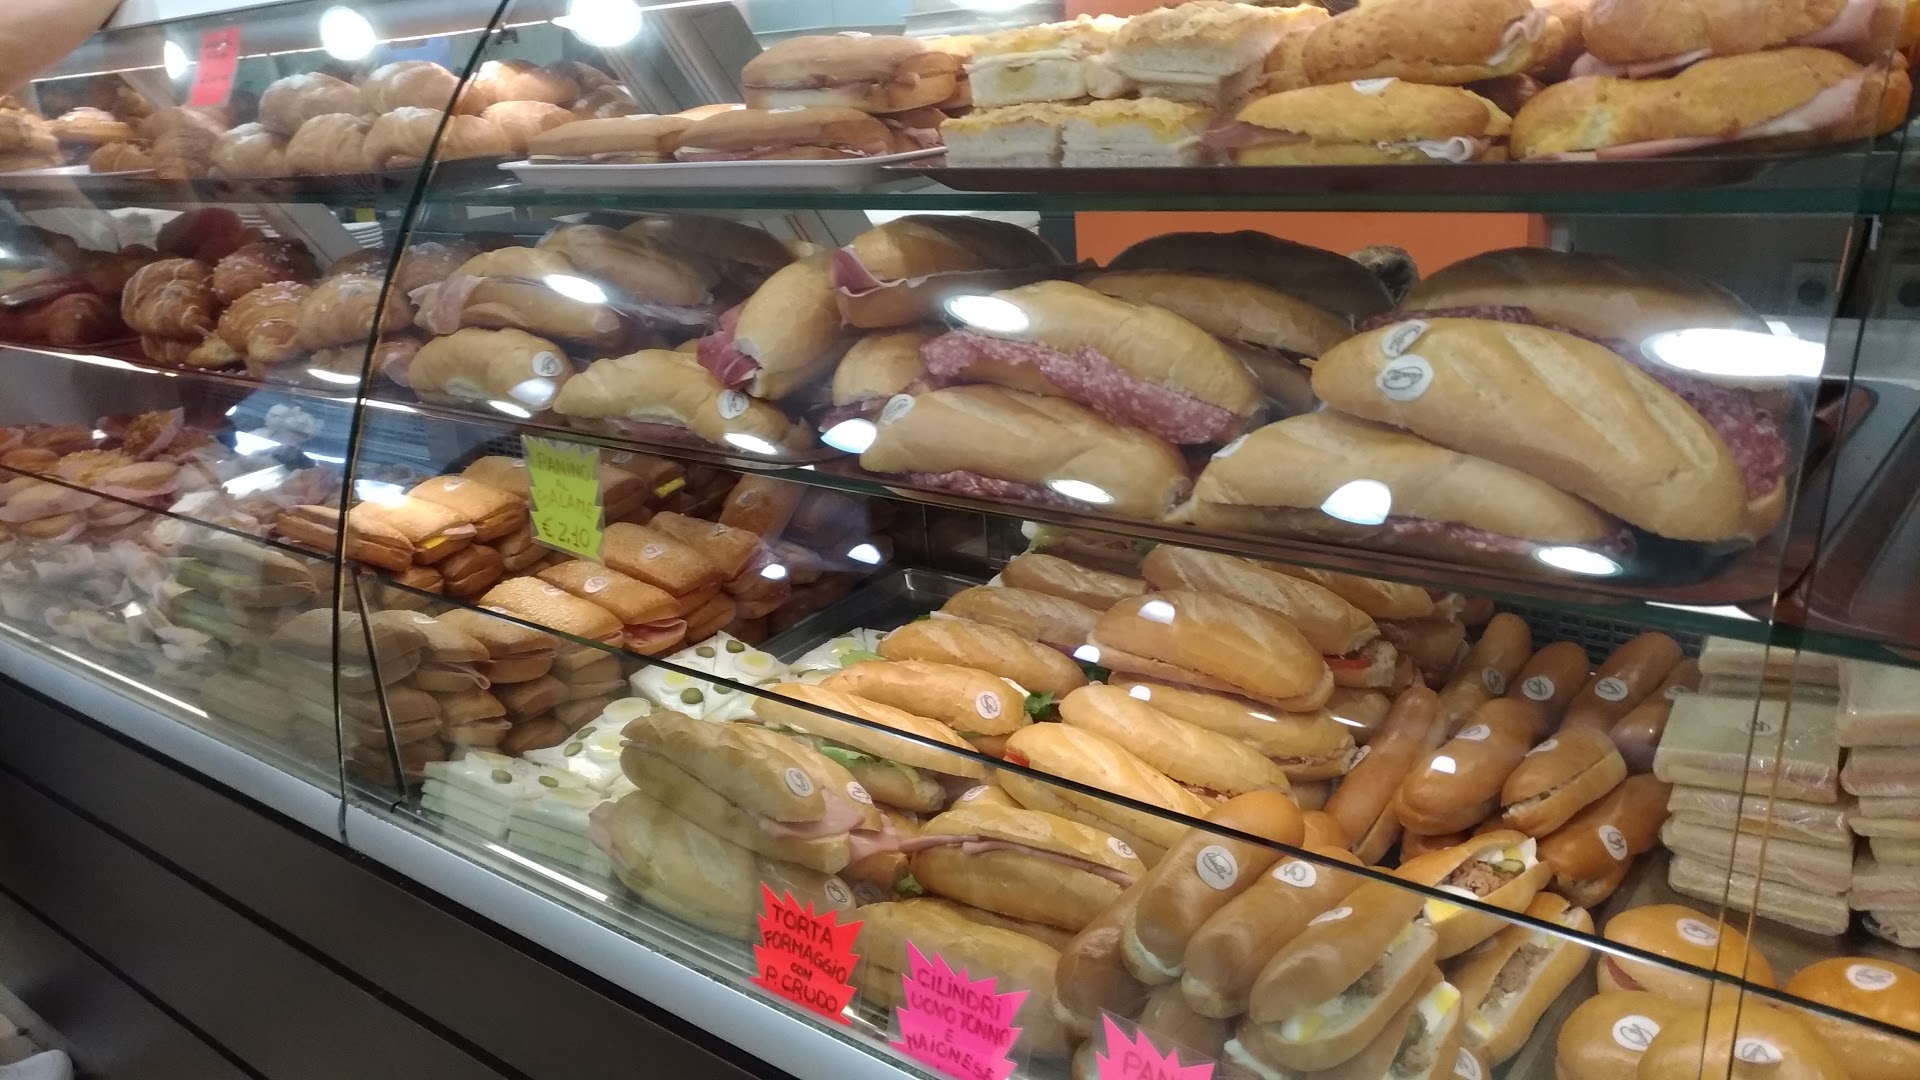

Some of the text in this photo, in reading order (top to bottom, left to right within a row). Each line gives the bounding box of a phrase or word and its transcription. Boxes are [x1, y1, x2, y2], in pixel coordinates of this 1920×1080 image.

[772, 903, 833, 950] TORTA
[763, 930, 847, 985] FORMAGGIO
[781, 975, 838, 1014] CRUDO
[917, 967, 1002, 1020] CILINDRI
[911, 991, 1011, 1047] UOVO TONNO
[944, 1029, 954, 1043] E
[1122, 1050, 1184, 1080] PAN
